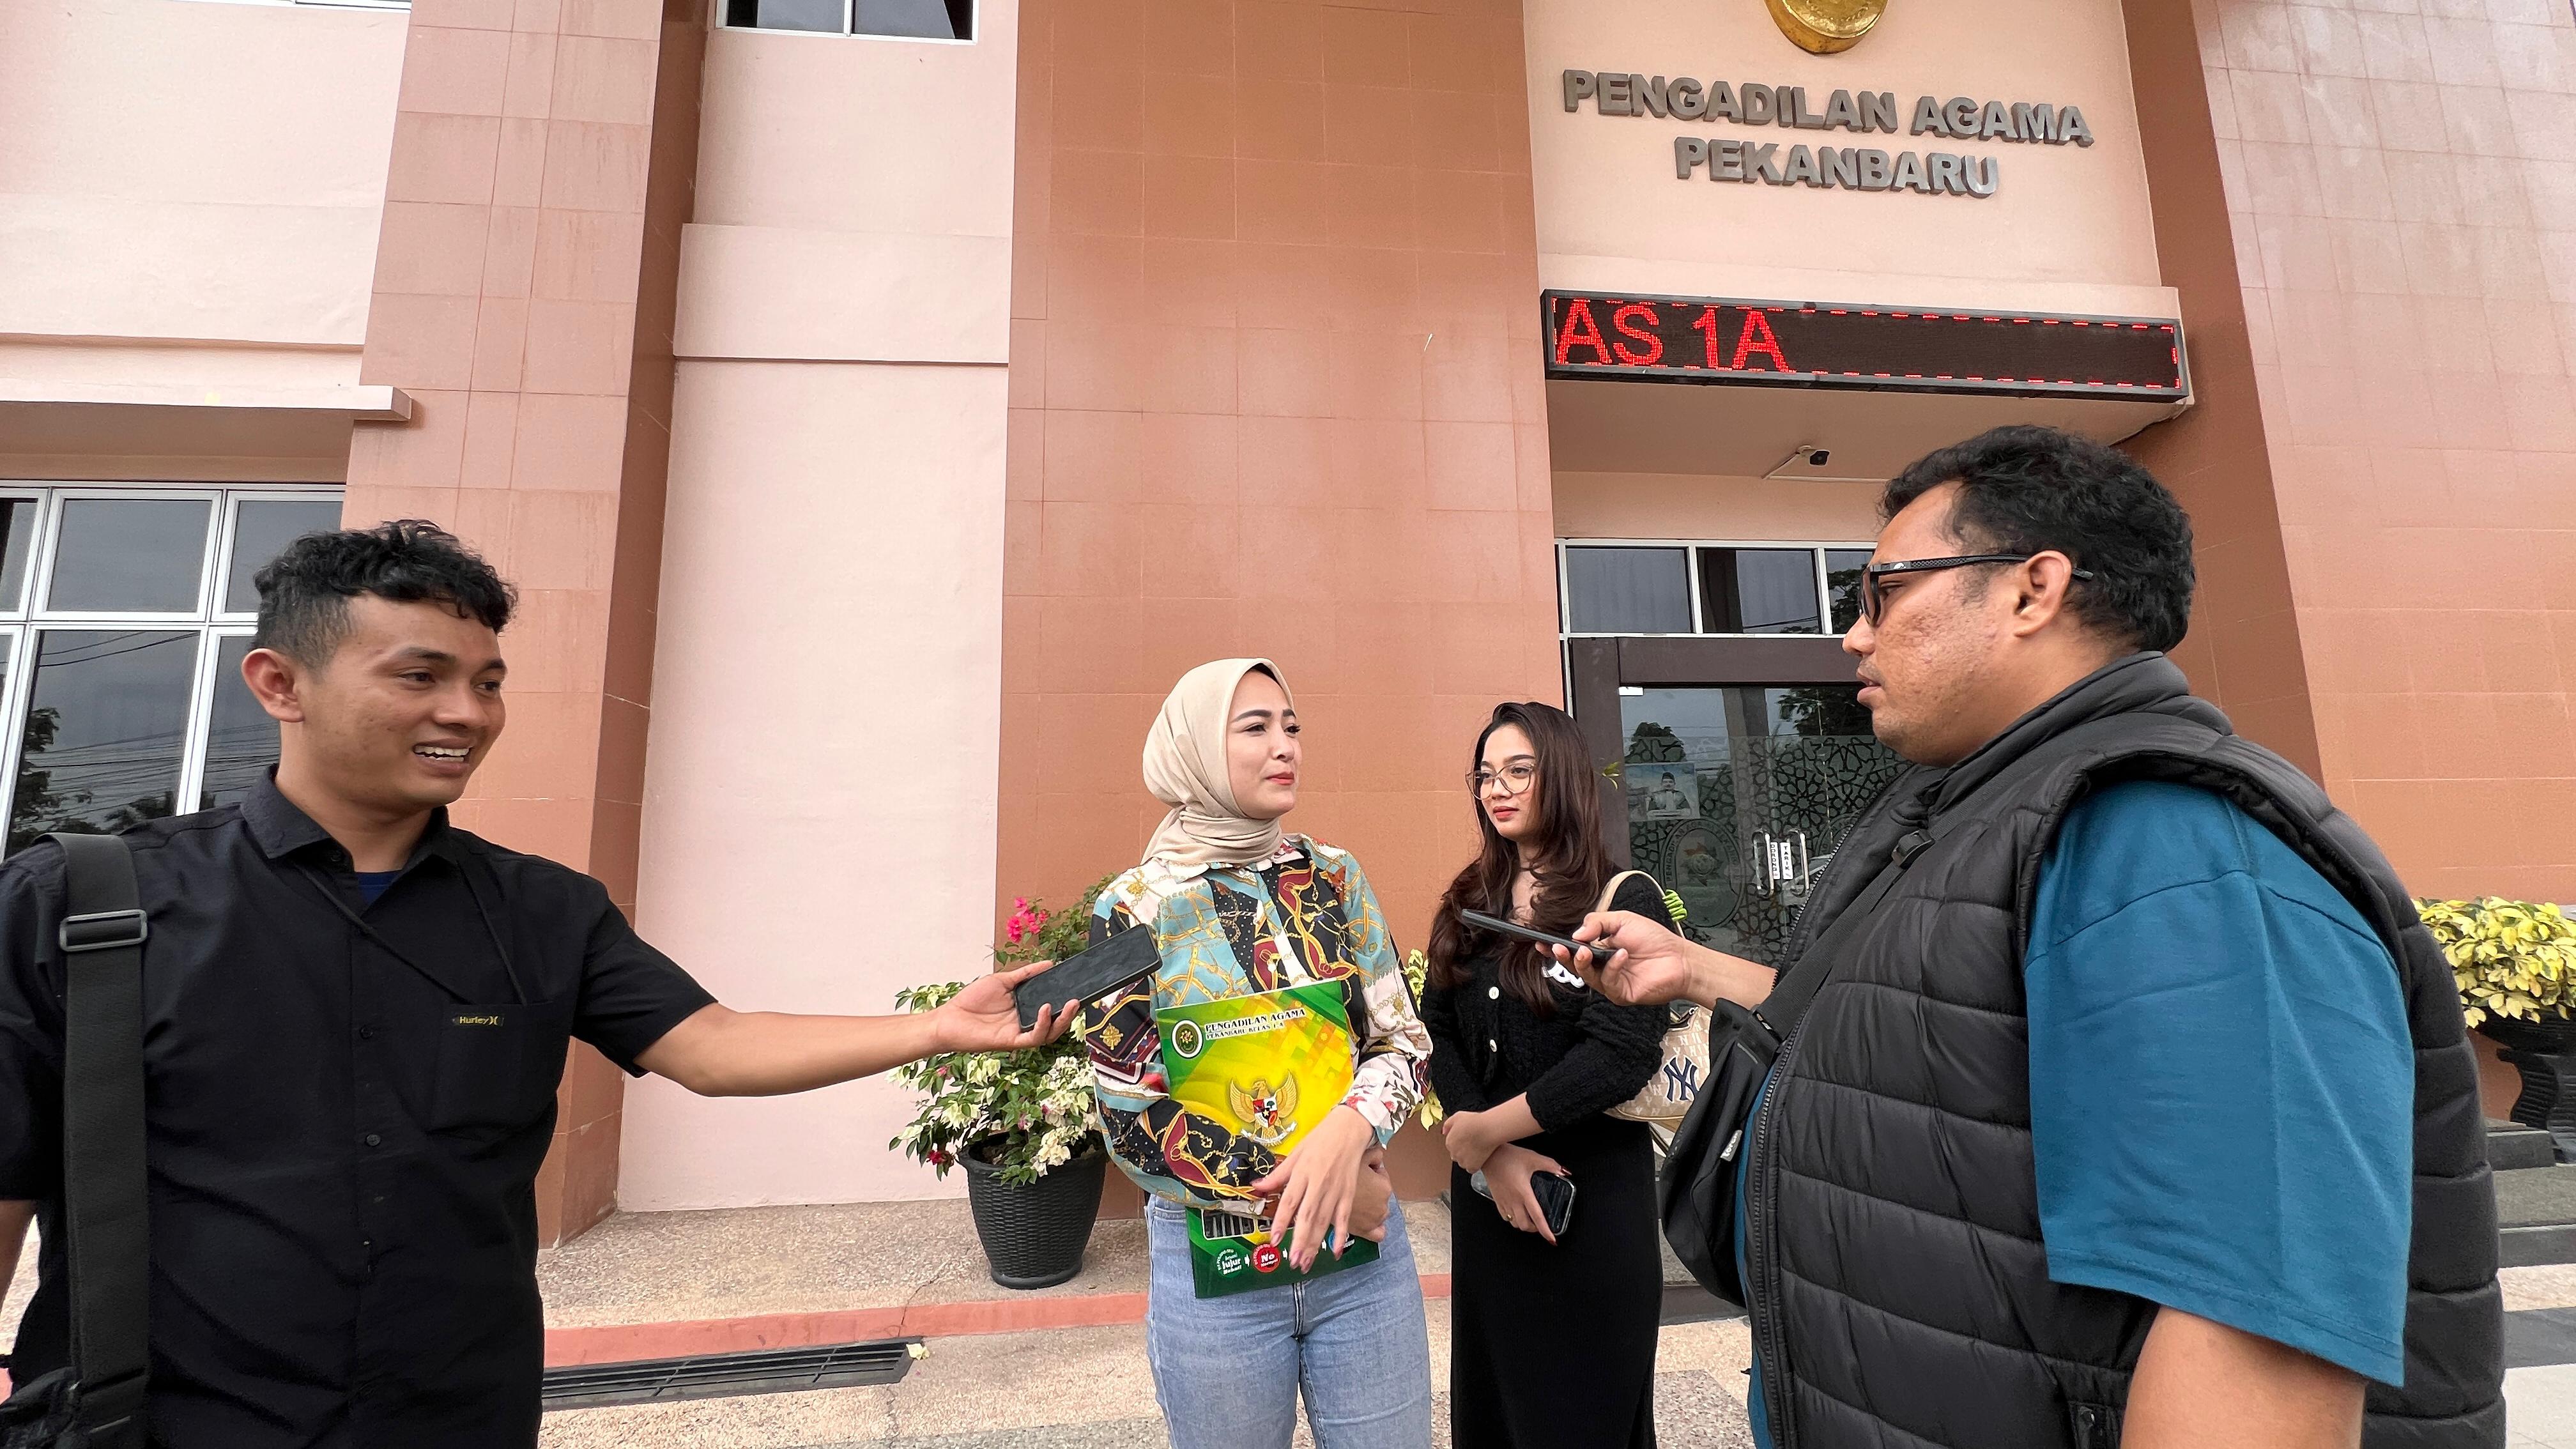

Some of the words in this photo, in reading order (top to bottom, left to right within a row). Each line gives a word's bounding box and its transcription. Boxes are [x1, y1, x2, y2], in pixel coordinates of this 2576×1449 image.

[1563, 69, 1898, 134] PENGADILAN
[1909, 96, 2094, 148] AGAMA
[1674, 136, 1999, 199] PEKANBARU
[1556, 300, 1663, 366] AS
[1690, 304, 1793, 374] 1A
[459, 1016, 489, 1025] Hurley
[1206, 1015, 1268, 1032] PENGADILAN
[1270, 1008, 1306, 1022] AGAMA
[1662, 1055, 1699, 1103] NY
[1222, 1257, 1241, 1270] Jujur
[1261, 1253, 1275, 1263] No
